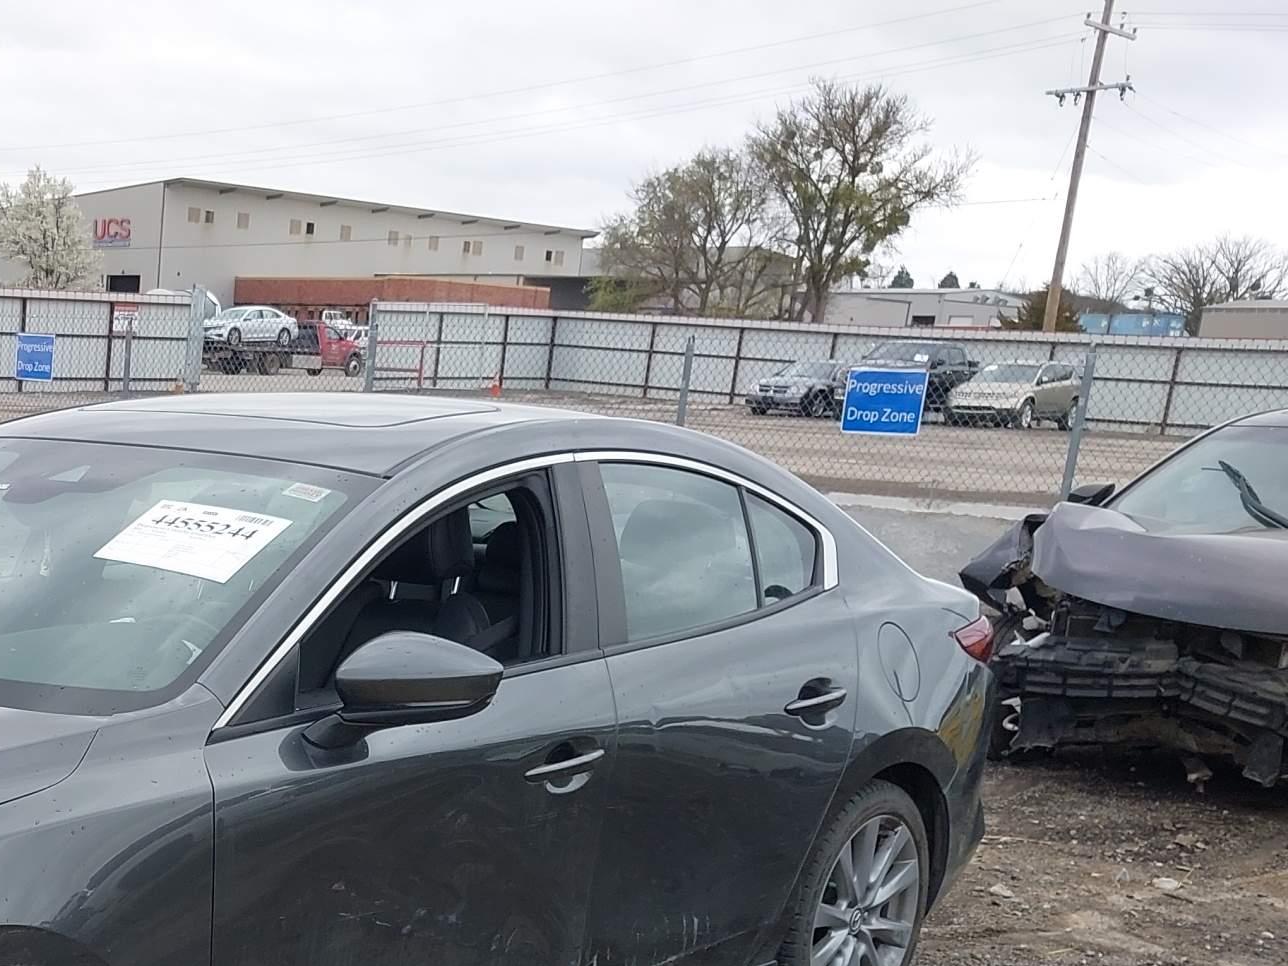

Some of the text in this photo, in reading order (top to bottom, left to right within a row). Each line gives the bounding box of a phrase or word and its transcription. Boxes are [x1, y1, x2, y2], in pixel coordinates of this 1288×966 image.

[94, 218, 131, 240] UCS
[18, 360, 51, 372] Drop Zone
[848, 379, 924, 396] Progressive
[847, 406, 915, 423] Drop Zone
[152, 514, 258, 540] 44555244
